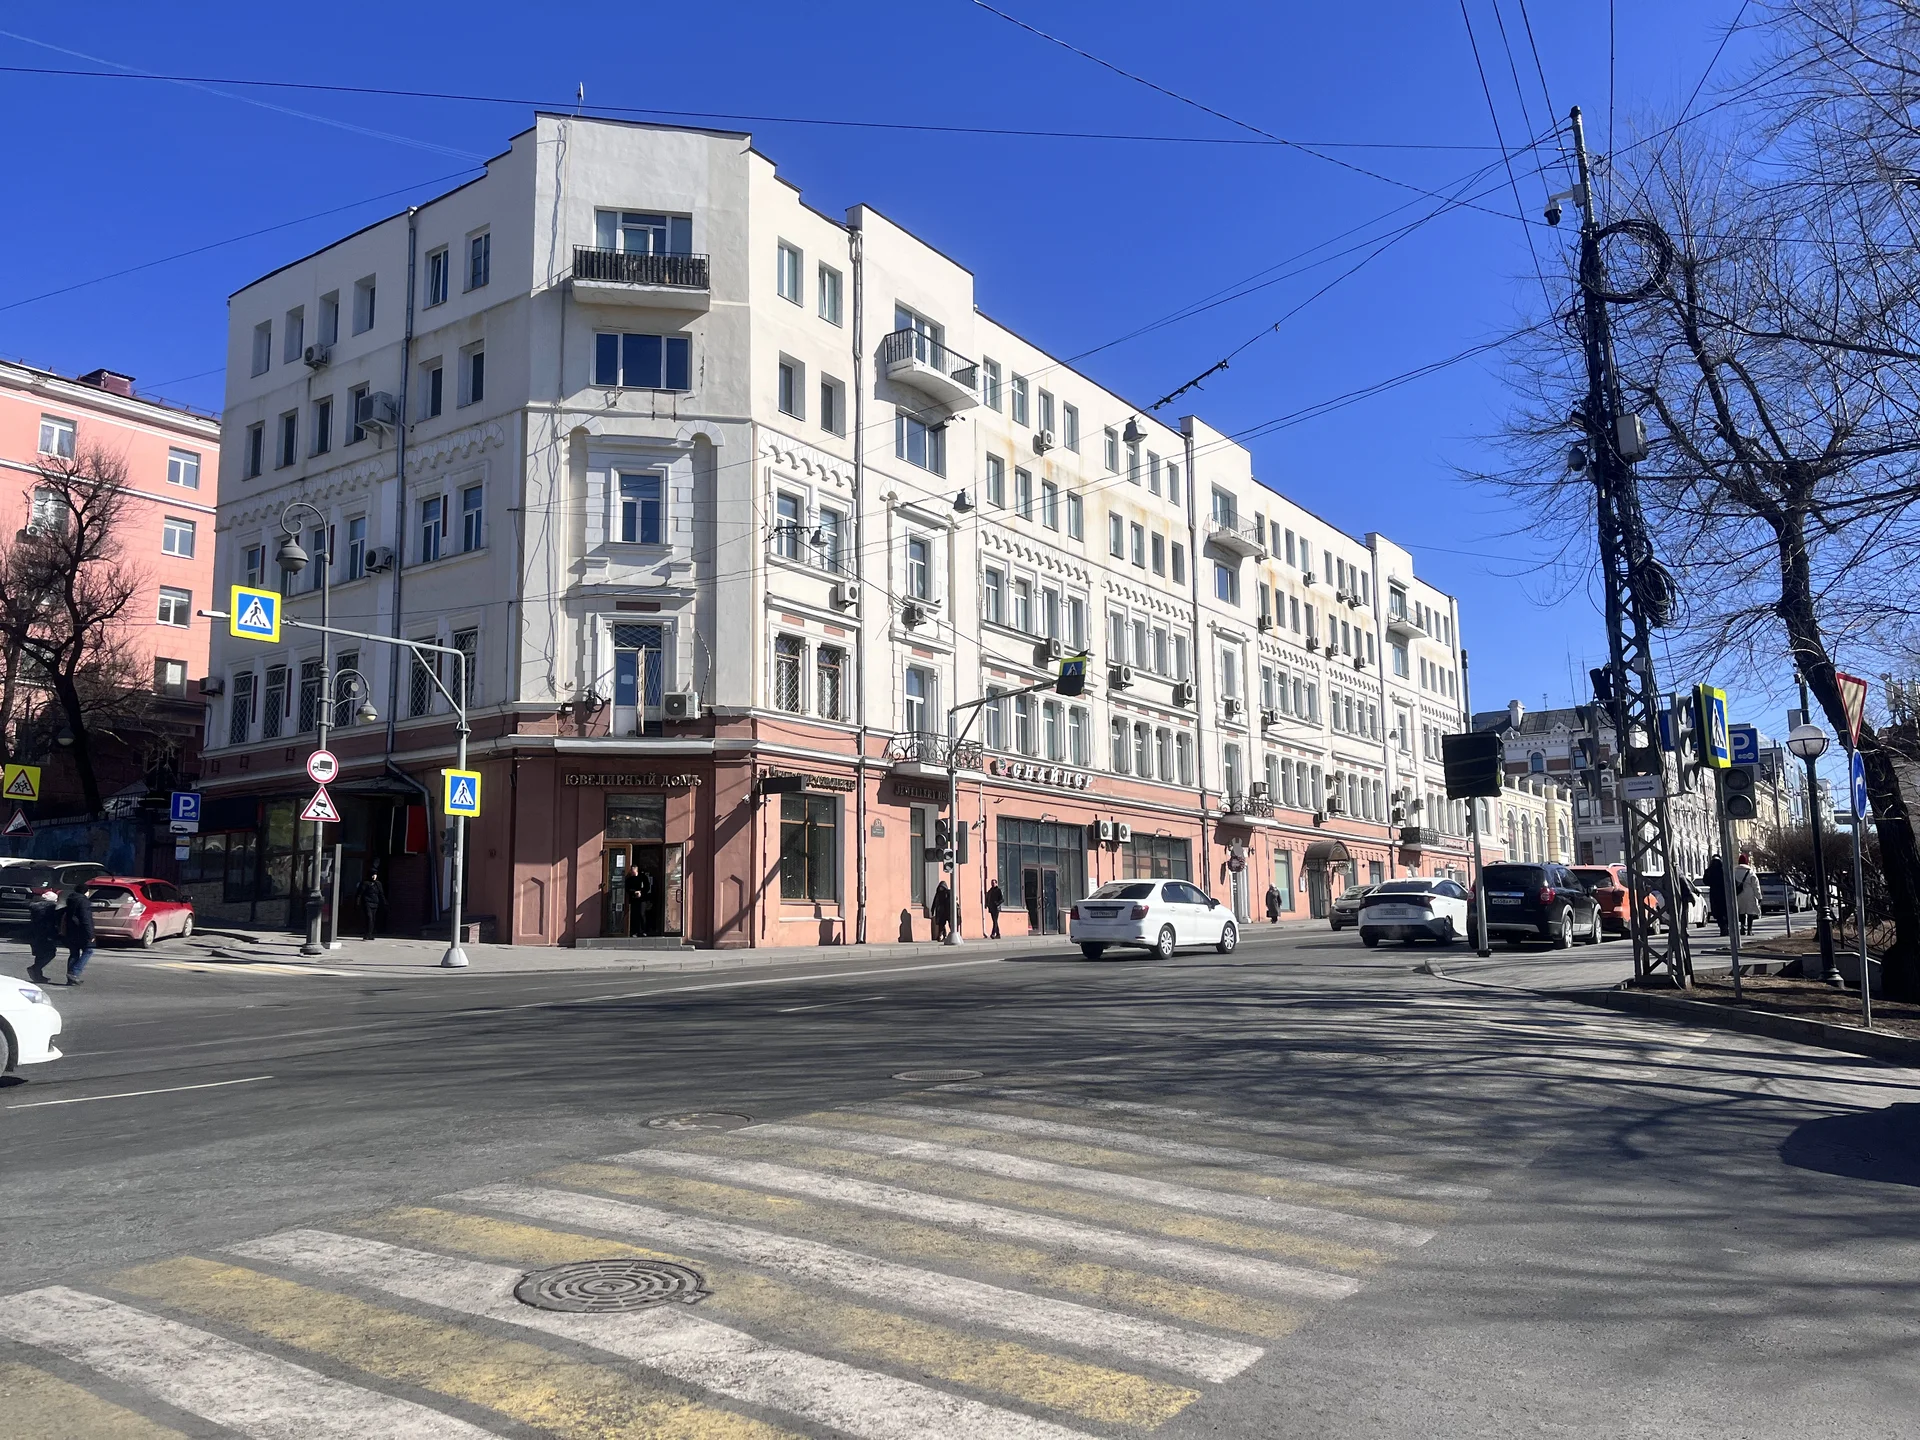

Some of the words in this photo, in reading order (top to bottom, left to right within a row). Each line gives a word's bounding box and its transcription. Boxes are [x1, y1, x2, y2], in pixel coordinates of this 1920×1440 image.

[564, 772, 657, 786] ЮВЕЛИРНЫЙ
[660, 774, 702, 788] ДОМЪ
[1013, 762, 1093, 788] СНАЙПЕР
[895, 785, 937, 799] JEWELLERY
